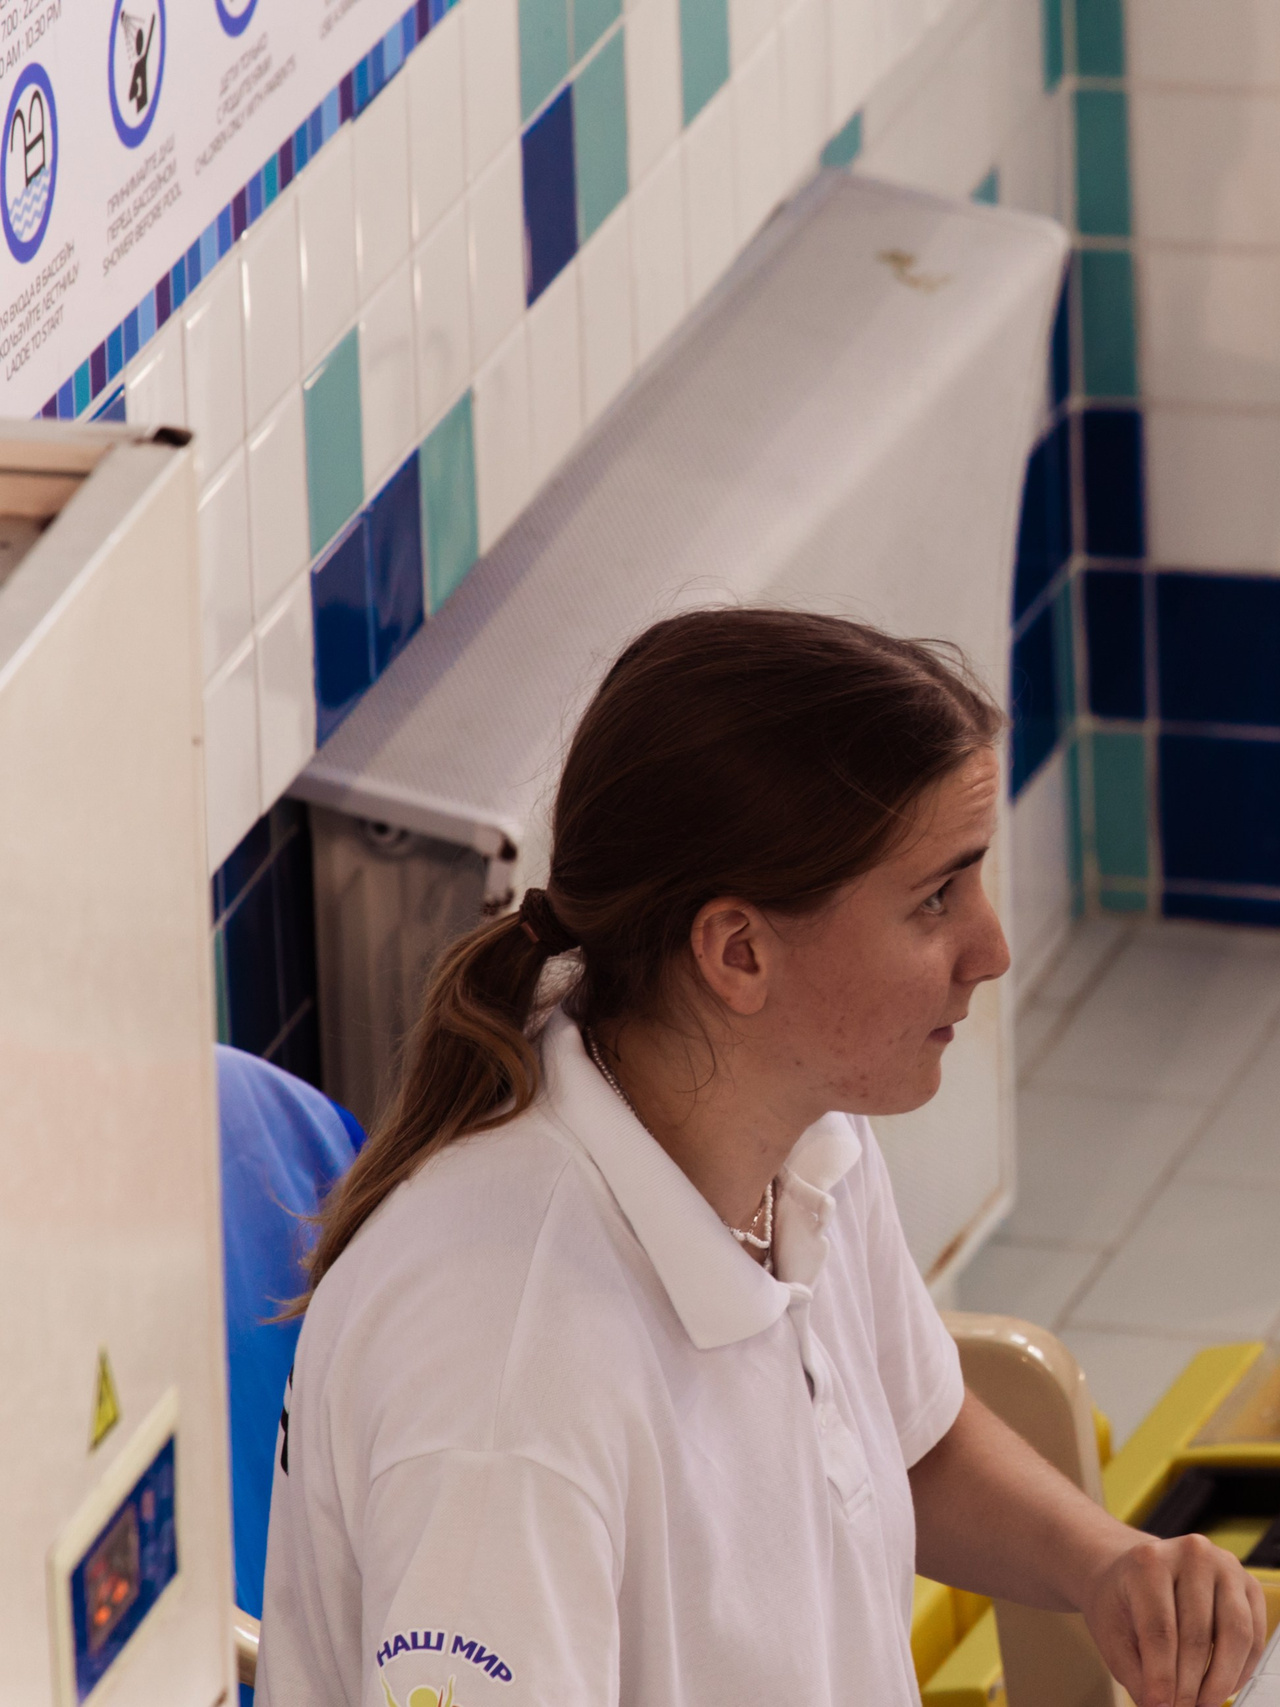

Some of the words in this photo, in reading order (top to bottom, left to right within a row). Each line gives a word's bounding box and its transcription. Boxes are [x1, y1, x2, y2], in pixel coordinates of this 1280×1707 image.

[6, 39, 20, 73] AM
[103, 231, 133, 277] SHOWER
[134, 202, 162, 243] BEFORE
[41, 303, 64, 343] START
[376, 1631, 445, 1668] НАШ
[451, 1635, 512, 1682] МИР
